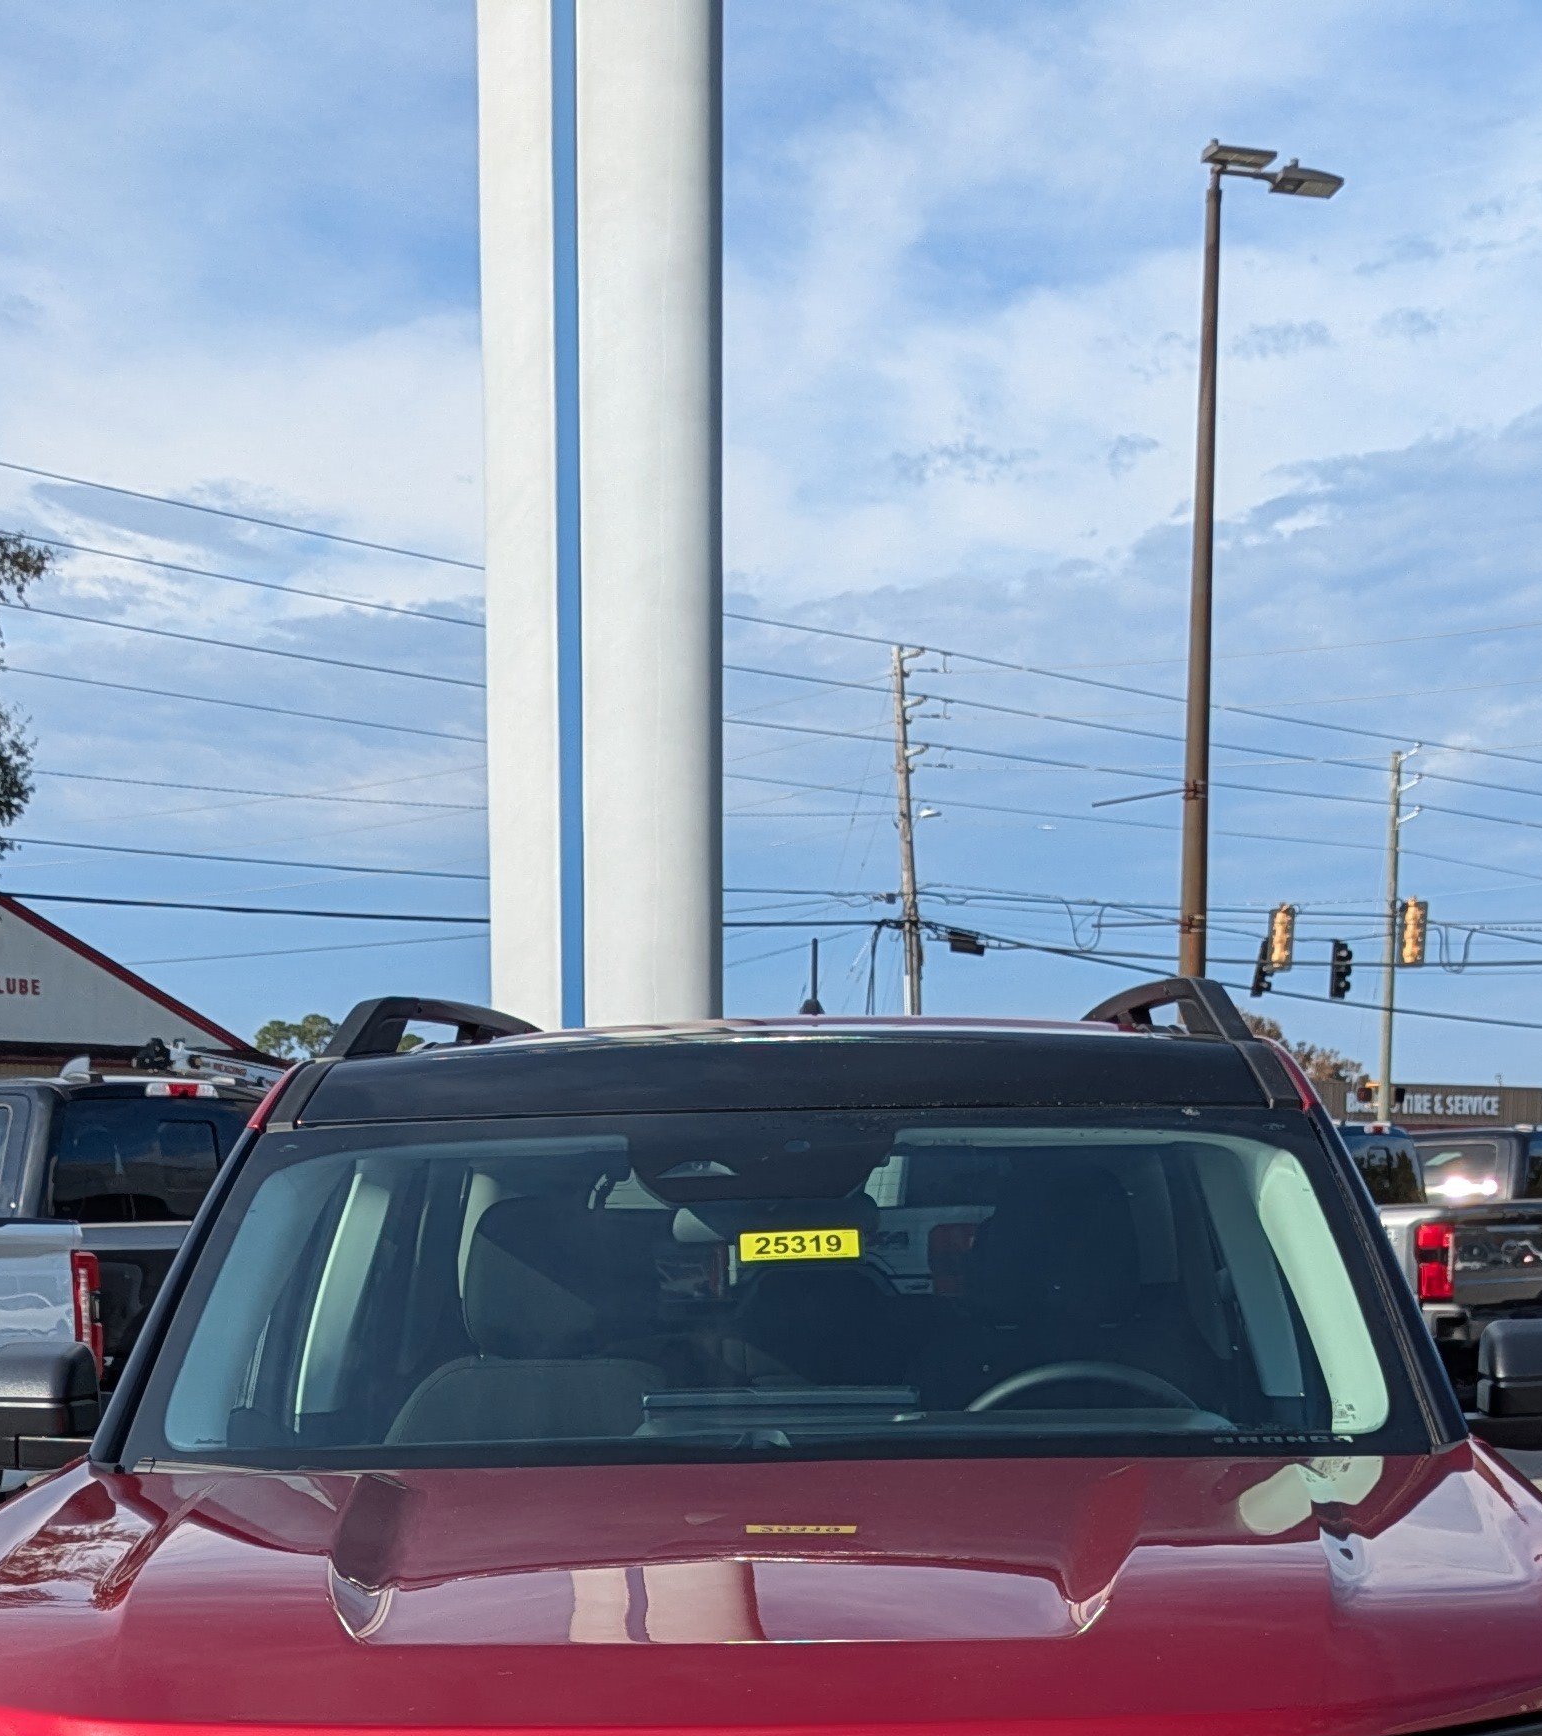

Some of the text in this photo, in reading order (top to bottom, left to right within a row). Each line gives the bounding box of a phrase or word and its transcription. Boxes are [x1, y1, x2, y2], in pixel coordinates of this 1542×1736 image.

[1402, 1092, 1431, 1115] TIRE
[1433, 1093, 1444, 1115] &
[1446, 1095, 1500, 1116] SERVICE
[754, 1234, 842, 1256] 25319
